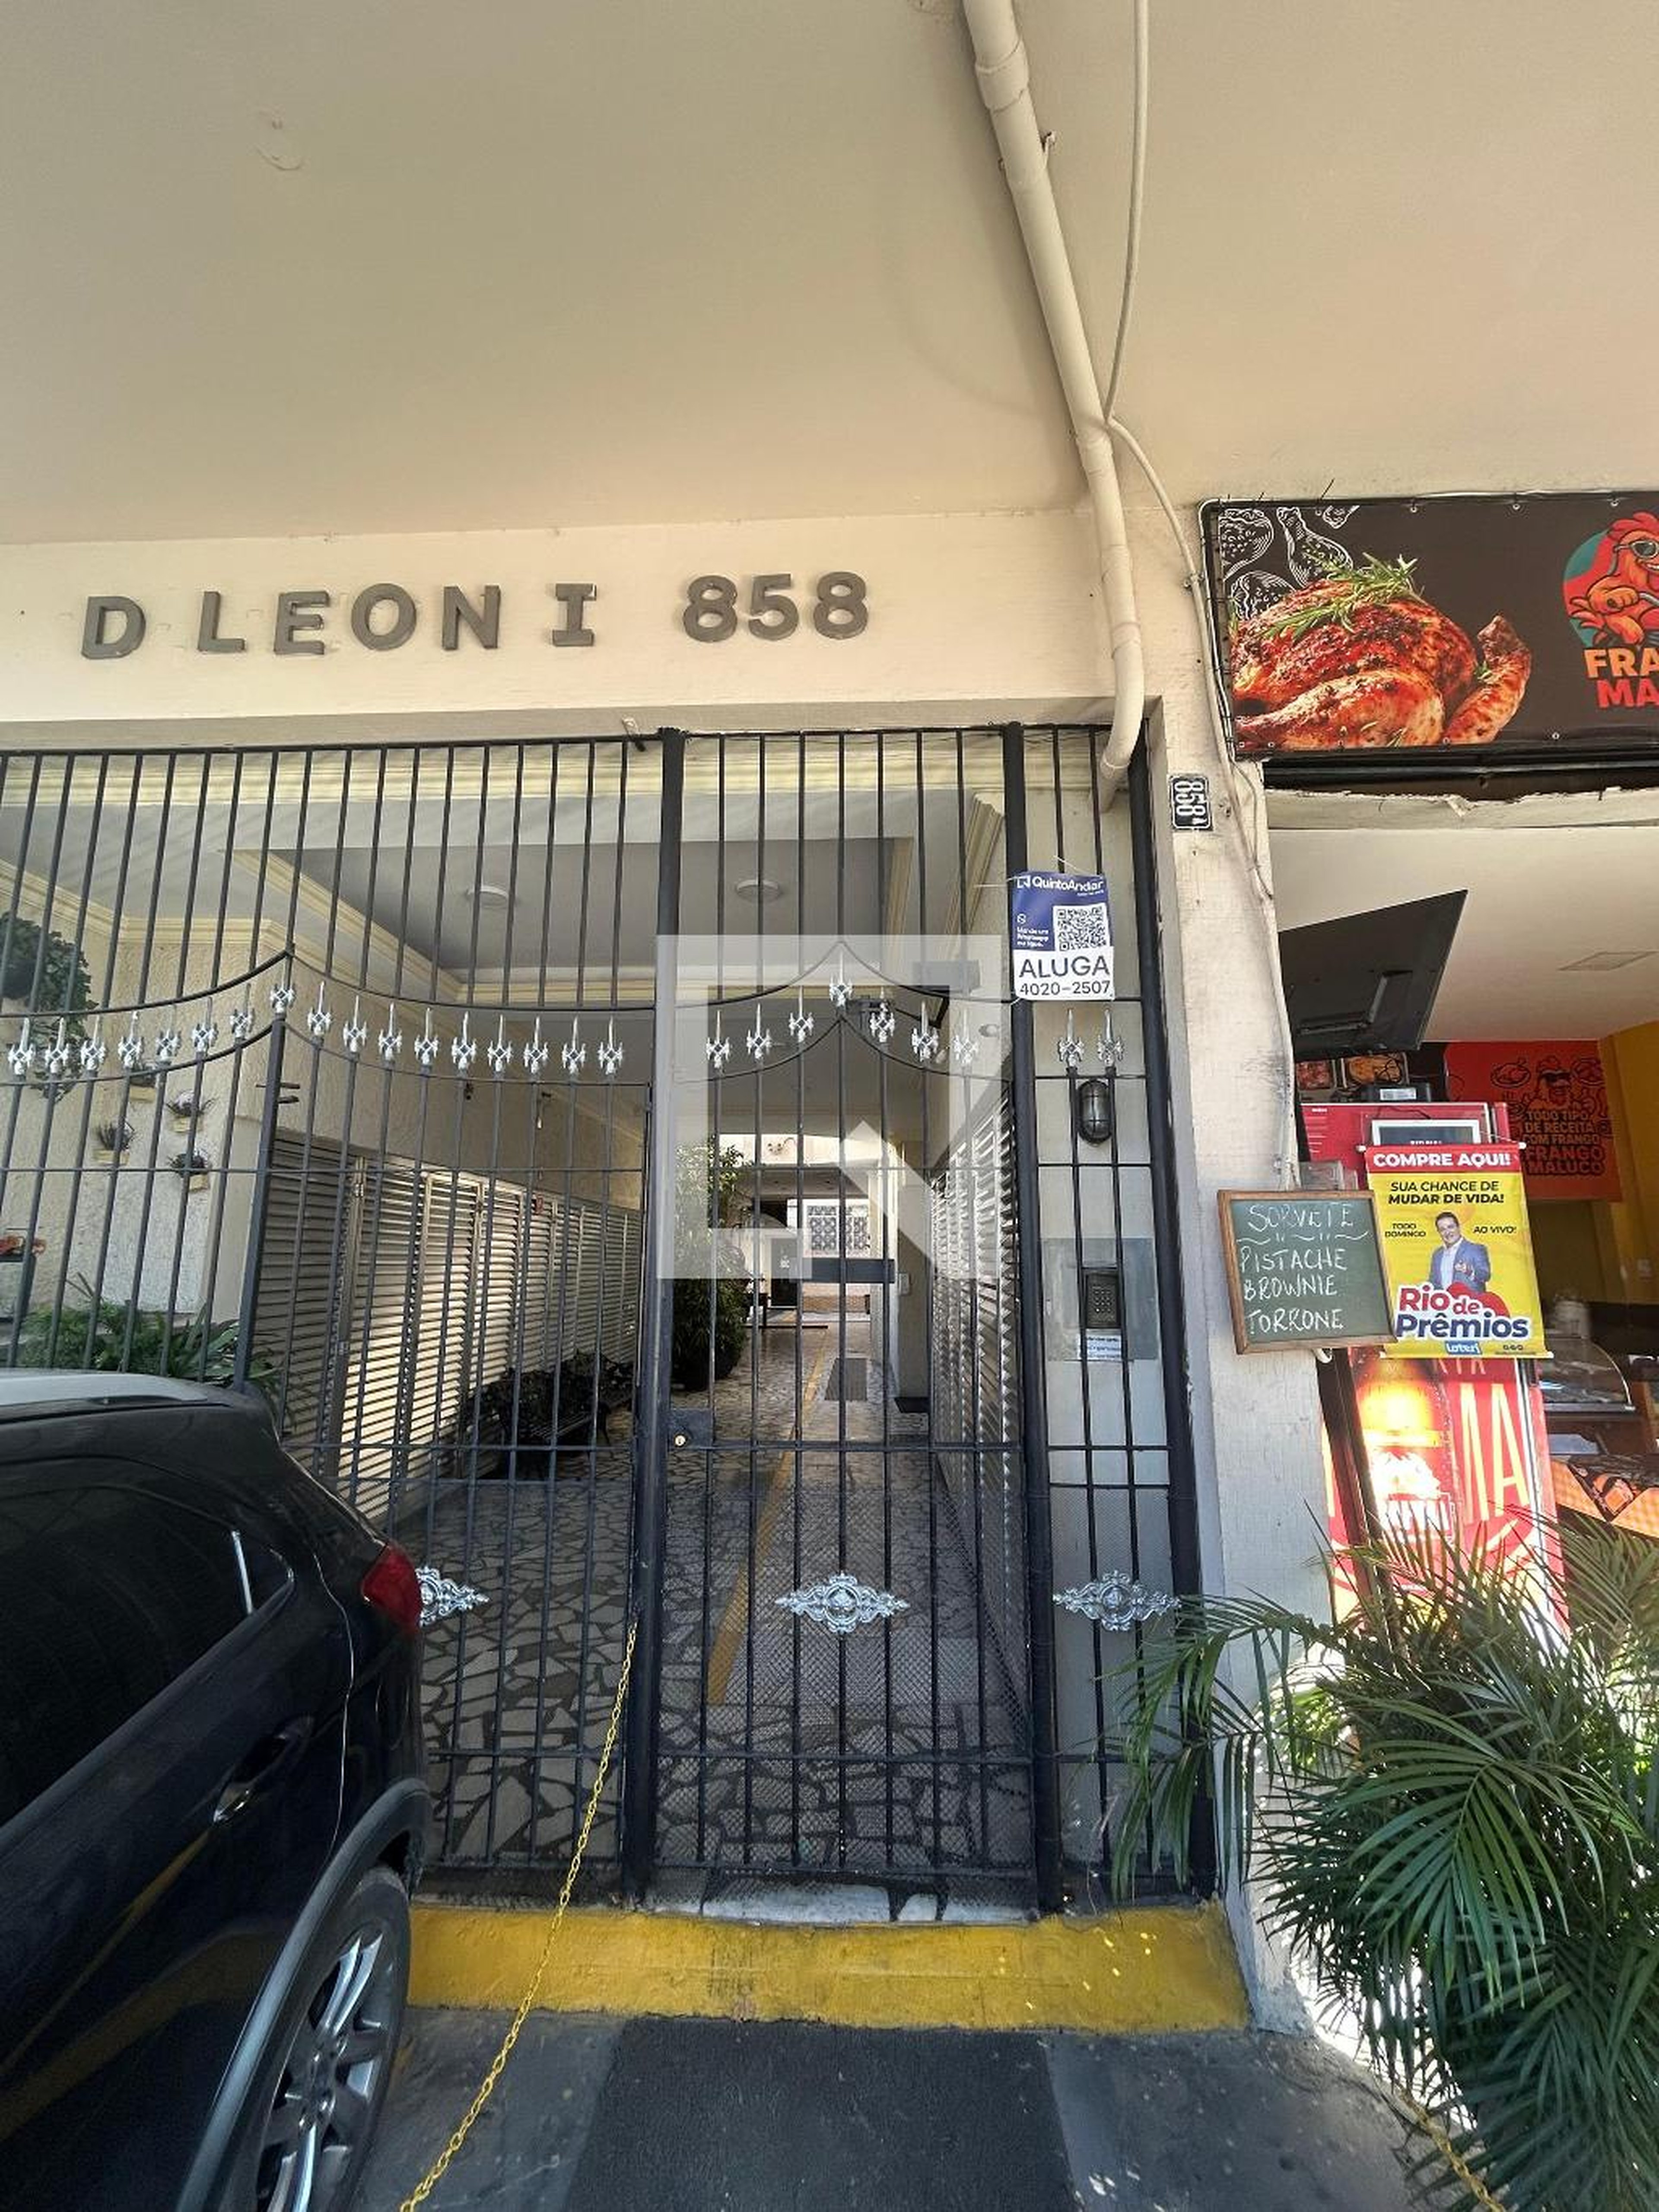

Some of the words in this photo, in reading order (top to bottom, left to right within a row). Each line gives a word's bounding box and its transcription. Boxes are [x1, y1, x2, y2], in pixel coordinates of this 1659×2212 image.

[81, 595, 146, 659] D
[683, 571, 868, 643] 858
[1584, 648, 1659, 678] FRA
[1597, 678, 1659, 708] MA
[1018, 956, 1110, 978] ALUGA
[1020, 980, 1110, 996] 4020-2507
[1373, 1153, 1453, 1166] COMPRE
[1458, 1153, 1510, 1168] AQUI!
[1388, 1194, 1439, 1204] MUDAR
[1443, 1194, 1462, 1203] DE
[1465, 1194, 1504, 1203] VIDA!
[1391, 1182, 1417, 1192] SUA
[1421, 1181, 1477, 1191] CHANCE
[1480, 1181, 1500, 1191] DE
[1239, 1246, 1348, 1273] PISTACHE
[1243, 1274, 1338, 1302] BROWNIE
[1399, 1285, 1450, 1312] Rio
[1452, 1297, 1480, 1314] de
[1245, 1308, 1344, 1335] TORRONE
[1395, 1311, 1529, 1338] Prêmios
